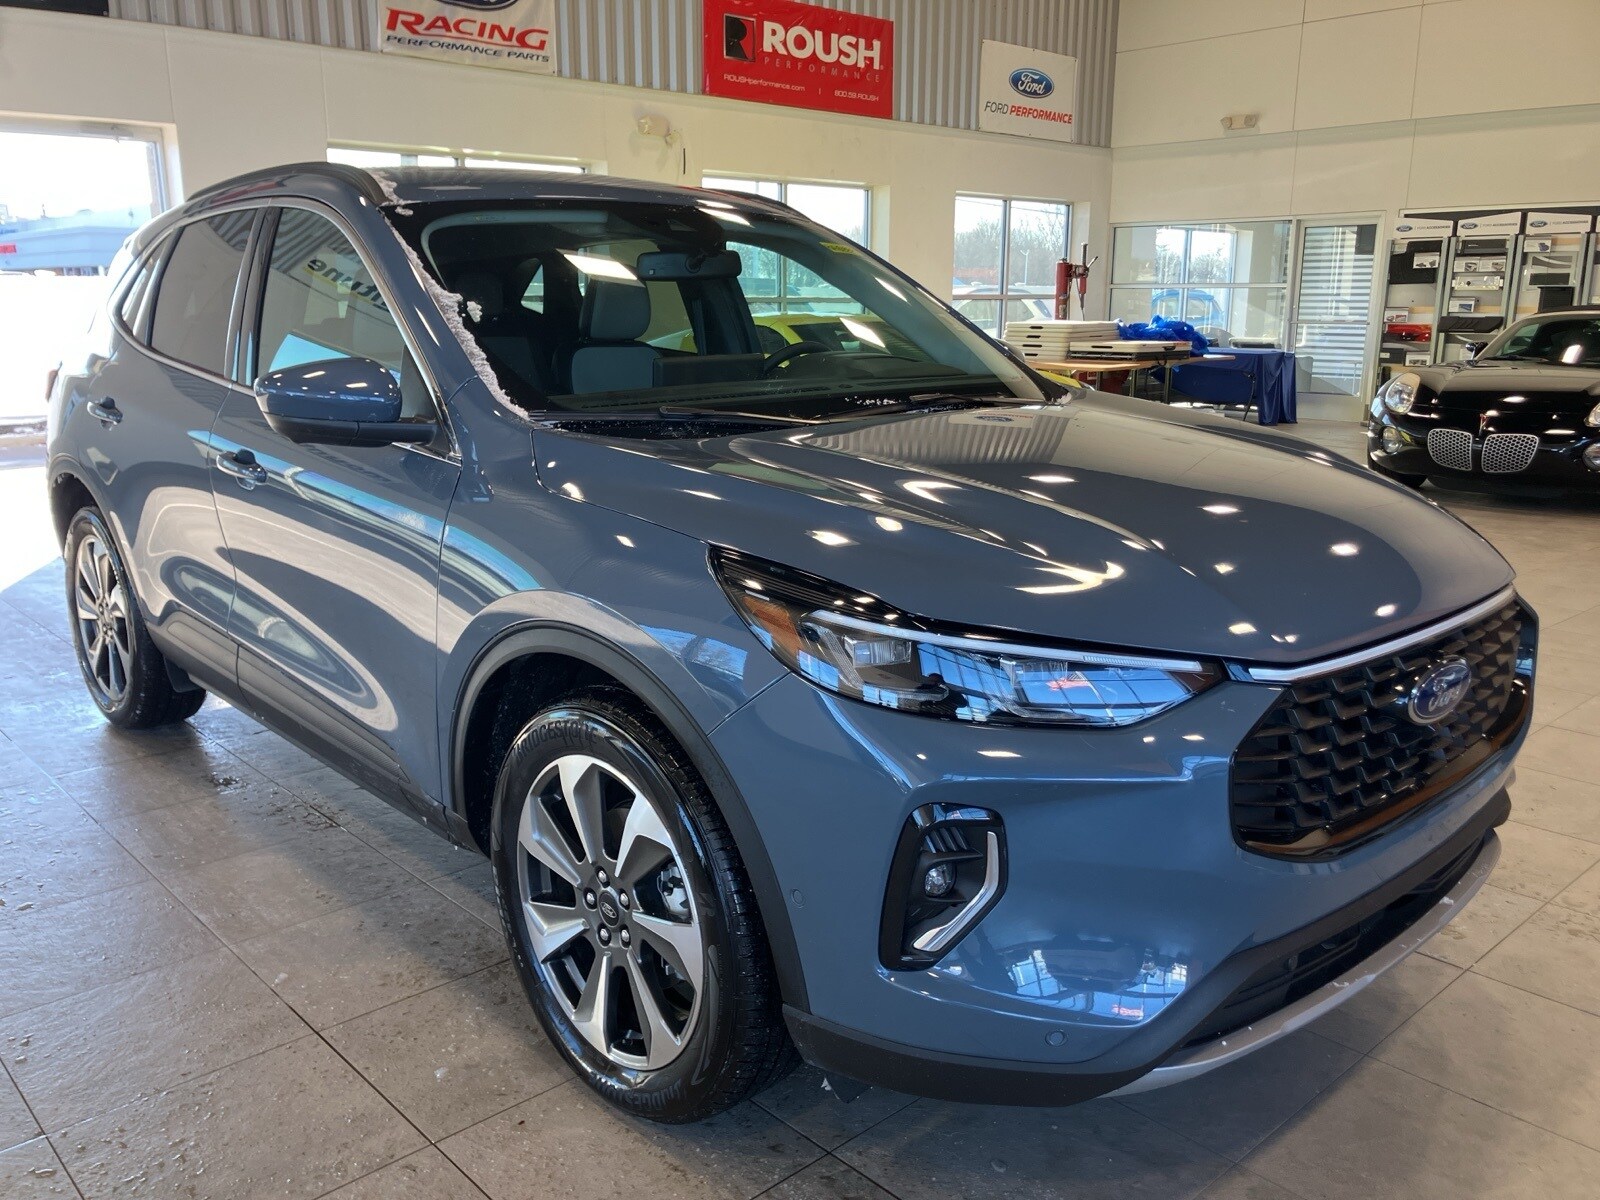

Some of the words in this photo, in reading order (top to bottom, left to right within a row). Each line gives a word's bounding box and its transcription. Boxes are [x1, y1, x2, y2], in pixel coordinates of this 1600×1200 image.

[386, 8, 549, 50] RACING
[386, 35, 501, 57] PERFORMANCE
[507, 51, 550, 63] PARTS
[763, 20, 881, 70] ROUSH
[764, 57, 880, 82] PERFORMANCE
[723, 73, 806, 92] ROUSHperformance.com
[1017, 72, 1046, 95] Ford
[984, 101, 1009, 115] FORD
[1009, 105, 1073, 124] PERFORMANCE
